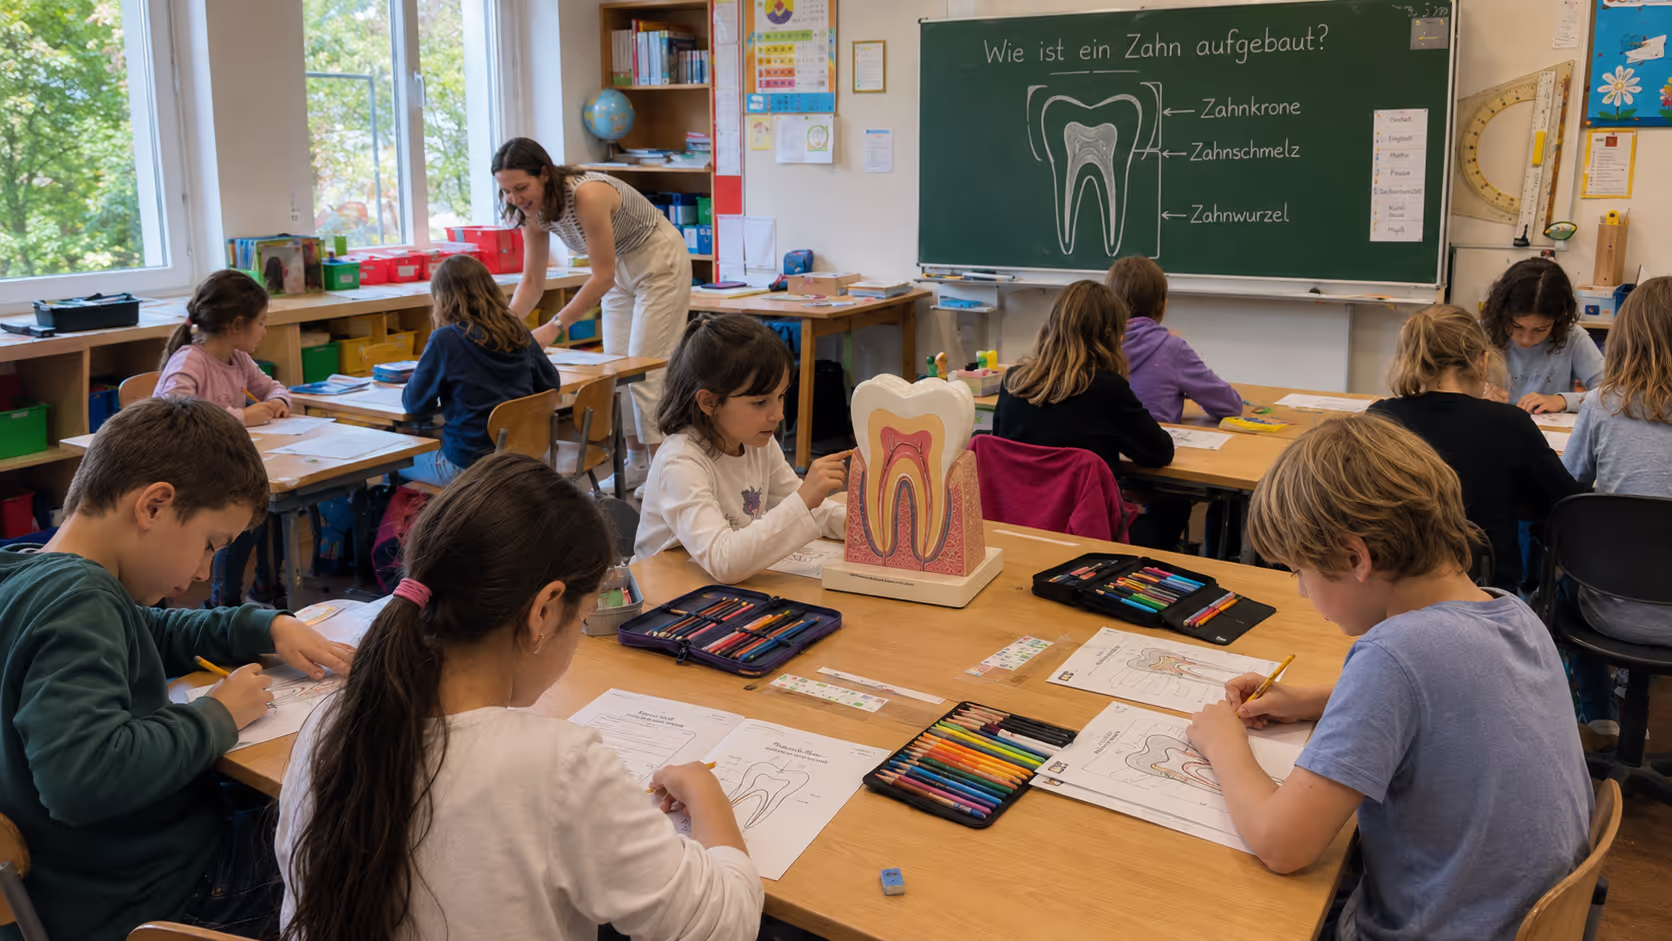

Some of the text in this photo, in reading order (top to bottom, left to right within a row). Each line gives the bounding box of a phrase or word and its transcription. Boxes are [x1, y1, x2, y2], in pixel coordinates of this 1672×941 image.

[983, 24, 1329, 65] Wie ist ein Zahn aufgebaut?
[1200, 96, 1302, 119] Zahnkrone
[1189, 140, 1301, 161] Zahnschmelz
[1189, 202, 1290, 224] Zahnwurzel
